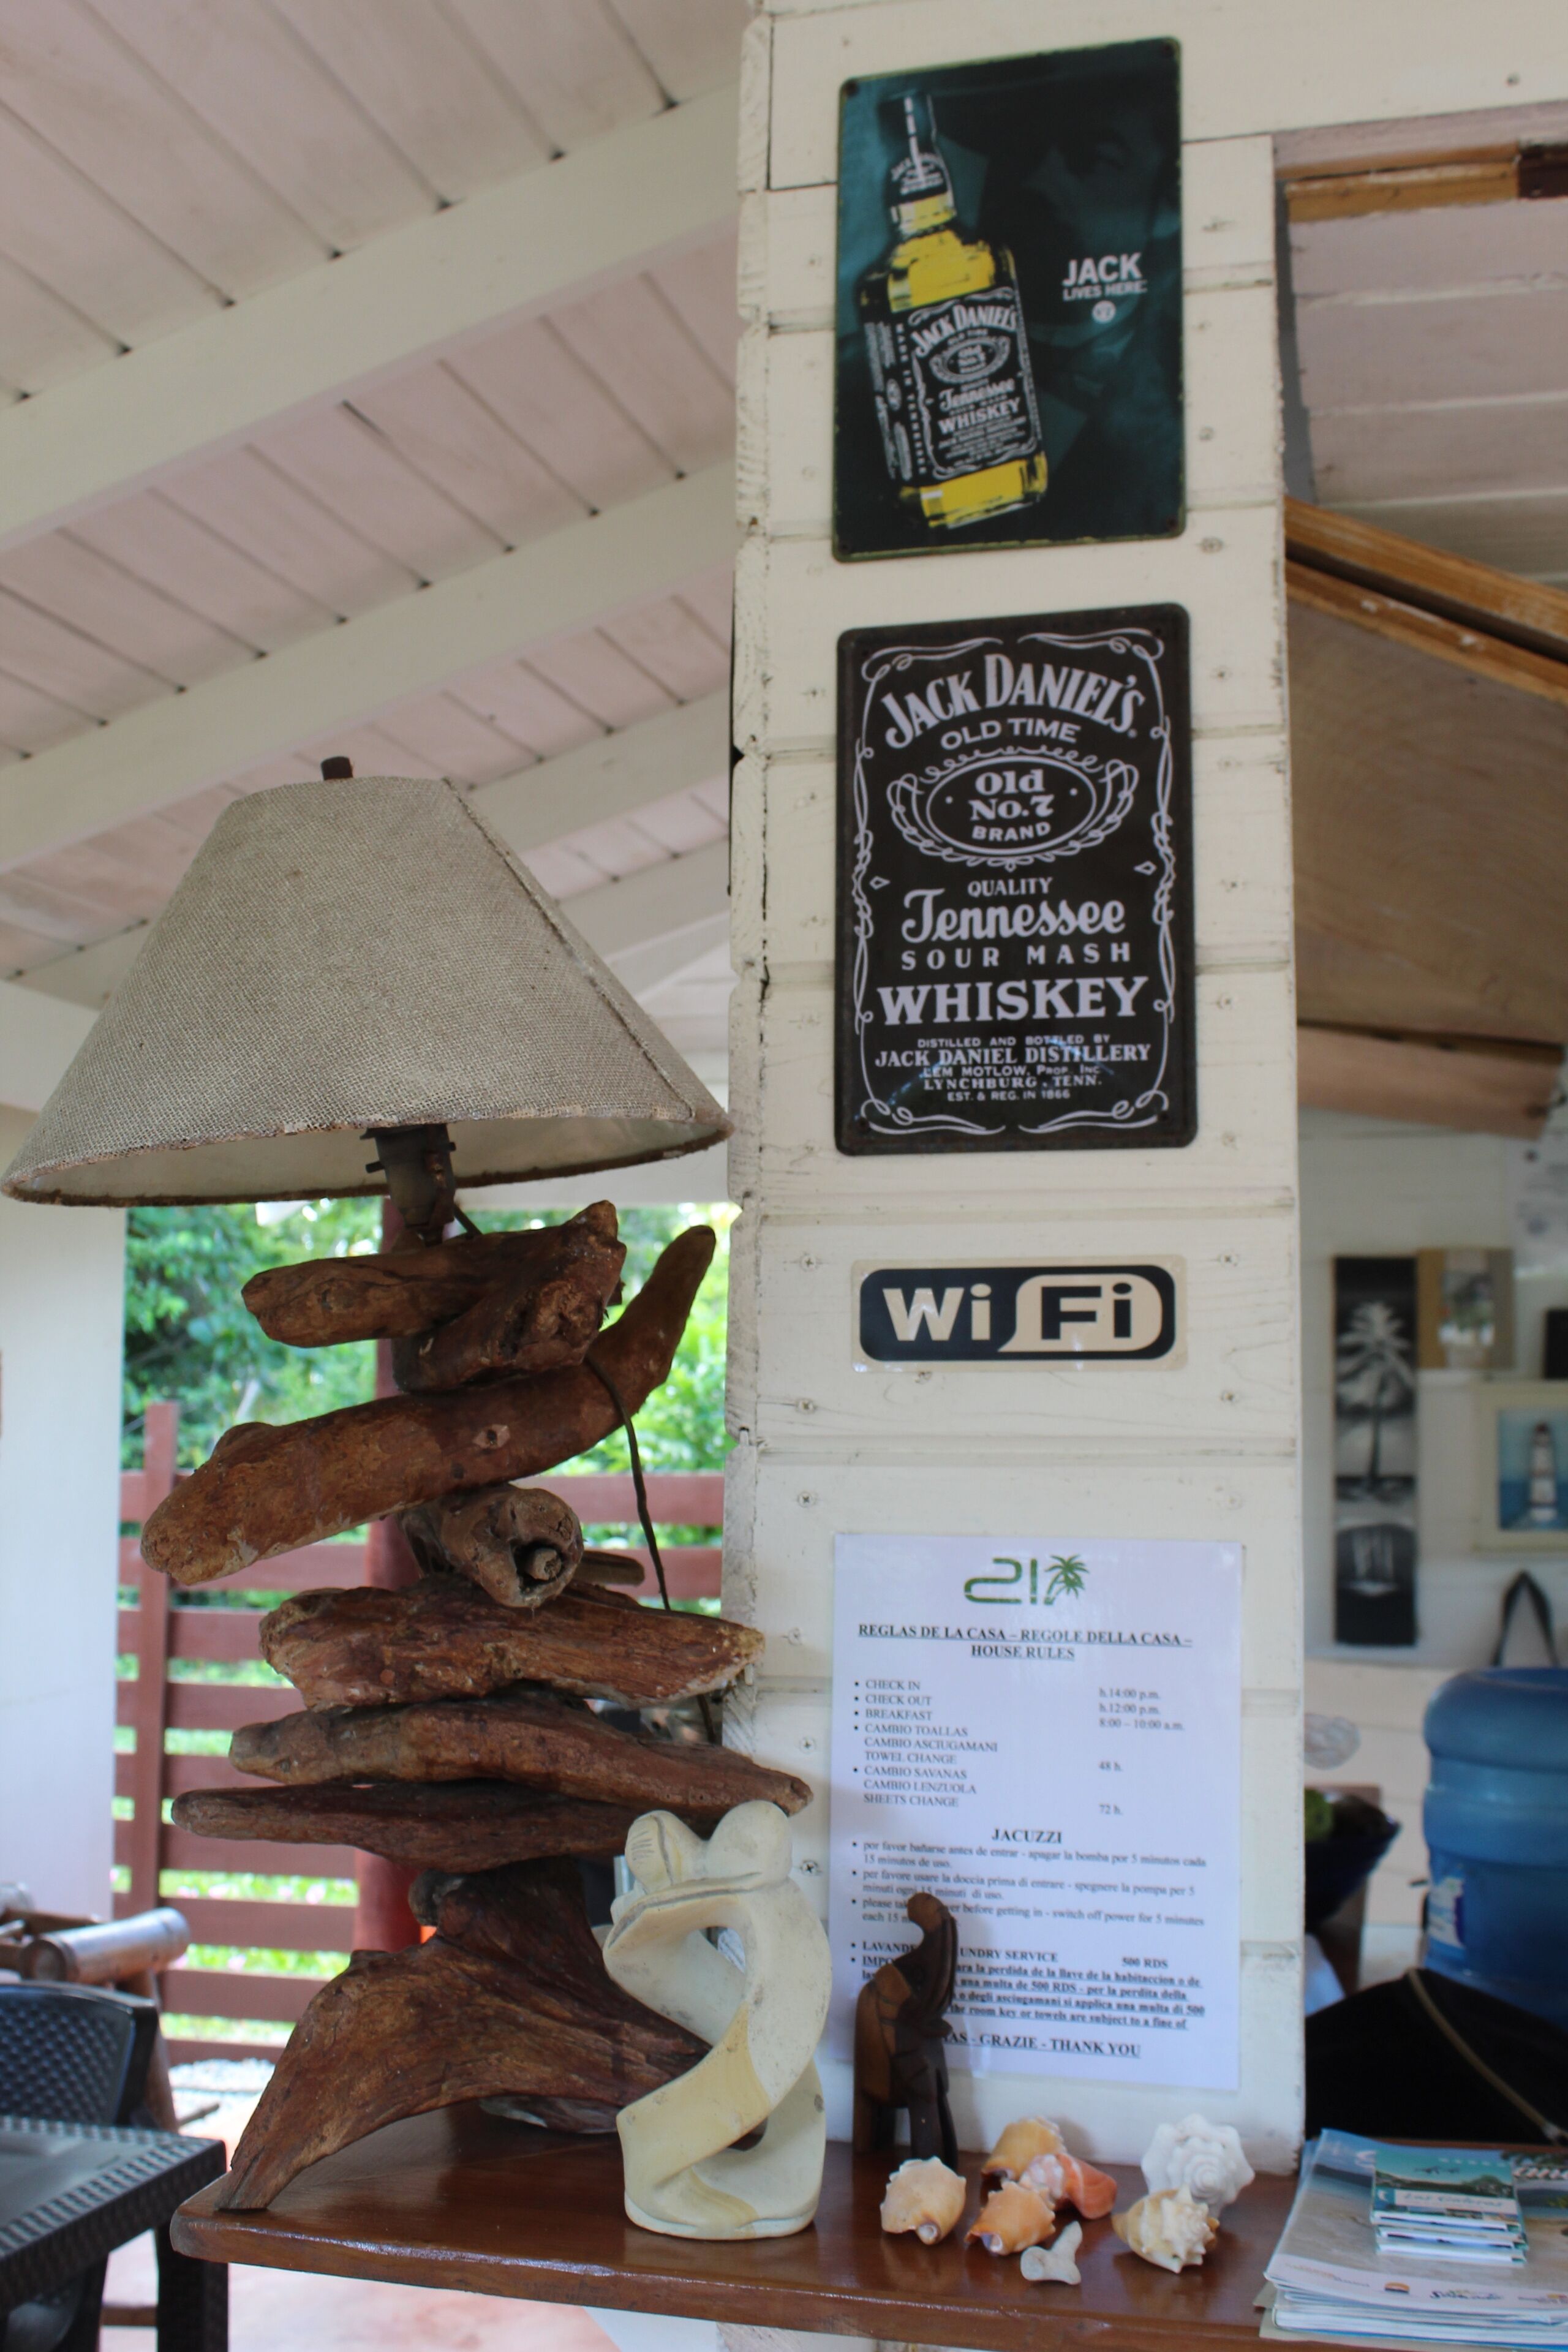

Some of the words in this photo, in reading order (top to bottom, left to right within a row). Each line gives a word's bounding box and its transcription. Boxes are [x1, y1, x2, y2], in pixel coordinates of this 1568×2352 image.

[1062, 252, 1143, 287] JACK
[1063, 285, 1102, 302] LIVES
[911, 314, 956, 358] JACK
[938, 397, 1021, 434] WHISKEY
[881, 671, 978, 748] JACK
[984, 653, 1145, 735] DANIEL'S
[940, 720, 1002, 750] OLD
[1008, 718, 1082, 744] TIME
[975, 770, 1045, 796] Old
[972, 821, 1052, 842] BRAND
[968, 878, 1052, 896] QUALITY
[900, 888, 1126, 943] Tennessee
[901, 949, 1000, 970] SOUR
[1027, 943, 1131, 965] MASH
[877, 976, 1148, 1026] WHISKEY
[917, 1038, 981, 1049] DISTILLED
[990, 1036, 1016, 1047] AND
[1025, 1035, 1084, 1046] BOTTLED
[1093, 1033, 1110, 1044] BY
[875, 1050, 930, 1067] JACK
[938, 1047, 1017, 1066] DANIEL
[1025, 1043, 1151, 1063] DISTILLERY
[923, 1067, 953, 1078] LEM
[1053, 1074, 1102, 1086] TENN.
[948, 1091, 974, 1101] EST.
[1023, 1090, 1036, 1099] IN
[1042, 1089, 1071, 1099] 1866
[859, 1624, 916, 1637] REGLAS
[921, 1626, 940, 1638] DE
[945, 1627, 963, 1638] LA
[967, 1627, 1005, 1640] CASA
[1021, 1629, 1083, 1642] REGOLE
[1087, 1630, 1137, 1643] DELLA
[1141, 1632, 1181, 1645] CASA
[971, 1645, 1022, 1657] HOUSE
[1026, 1646, 1075, 1659] RULES
[865, 1679, 904, 1691] CHECK
[908, 1680, 921, 1691] IN
[865, 1694, 904, 1705] CHECK
[908, 1695, 932, 1706] OUT
[865, 1708, 932, 1721] BREAKFAST
[865, 1723, 911, 1735] CAMBIO
[916, 1725, 968, 1737] TOALLAS
[864, 1737, 911, 1748] CAMBIO
[914, 1740, 998, 1752] ASCIUGAMANI
[865, 1751, 905, 1762] TOWEL
[907, 1752, 957, 1765] CHANGE
[864, 1765, 911, 1777] CAMBIO
[914, 1768, 968, 1779] SAVANAS
[864, 1779, 911, 1791] CAMBIO
[914, 1782, 976, 1795] LENZUOLA
[864, 1794, 907, 1804] SHEETS
[909, 1795, 959, 1807] CHANGE
[992, 1828, 1062, 1844] JACUZZI
[882, 1841, 907, 1852] favor
[976, 1845, 988, 1856] de
[1064, 1850, 1072, 1860] la
[1075, 1852, 1109, 1862] bomba
[864, 1855, 875, 1864] 15
[878, 1856, 916, 1866] minutos
[918, 1857, 930, 1867] de
[881, 1869, 911, 1881] favore
[914, 1873, 938, 1882] usare
[941, 1873, 951, 1883] la
[953, 1875, 985, 1885] doccia
[987, 1876, 1016, 1888] prima
[973, 1888, 982, 1899] di
[862, 1898, 892, 1909] please
[962, 1903, 993, 1914] before
[997, 1906, 1030, 1918] getting
[1033, 1907, 1043, 1917] in
[1052, 1909, 1085, 1920] switch
[1087, 1910, 1102, 1920] off
[1139, 1912, 1152, 1923] for
[862, 1912, 884, 1922] each
[888, 1913, 899, 1923] 15
[960, 1948, 1000, 1958] UNDRY
[1005, 1950, 1058, 1962] SERVICE
[976, 1963, 984, 1973] la
[989, 1965, 1027, 1977] perdida
[1031, 1967, 1043, 1977] de
[1047, 1968, 1055, 1978] la
[1087, 1970, 1098, 1980] de
[1102, 1971, 1110, 1981] la
[1188, 1976, 1199, 1987] de
[1016, 1981, 1027, 1991] de
[1161, 1989, 1186, 2000] della
[1000, 2006, 1017, 2019] key
[1035, 2010, 1066, 2020] towels
[980, 2034, 1037, 2049] GRAZIE
[1050, 2037, 1103, 2054] THANK
[1109, 2041, 1142, 2057] YOU
